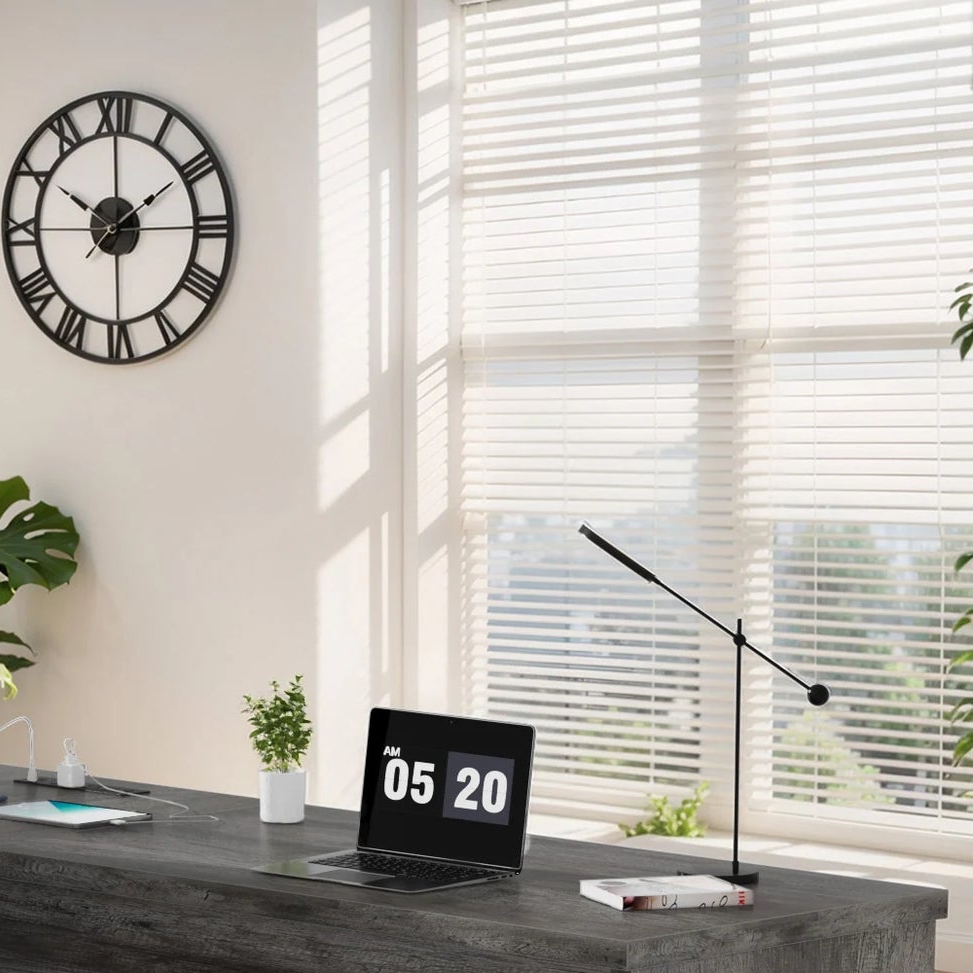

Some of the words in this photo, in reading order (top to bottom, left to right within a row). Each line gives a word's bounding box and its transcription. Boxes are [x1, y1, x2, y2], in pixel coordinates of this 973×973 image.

[48, 111, 83, 156] XI
[95, 97, 133, 135] XII
[153, 110, 174, 146] I
[13, 156, 51, 190] X
[195, 214, 228, 239] III
[383, 746, 400, 757] AM
[384, 758, 435, 804] 05
[454, 767, 507, 813] 20
